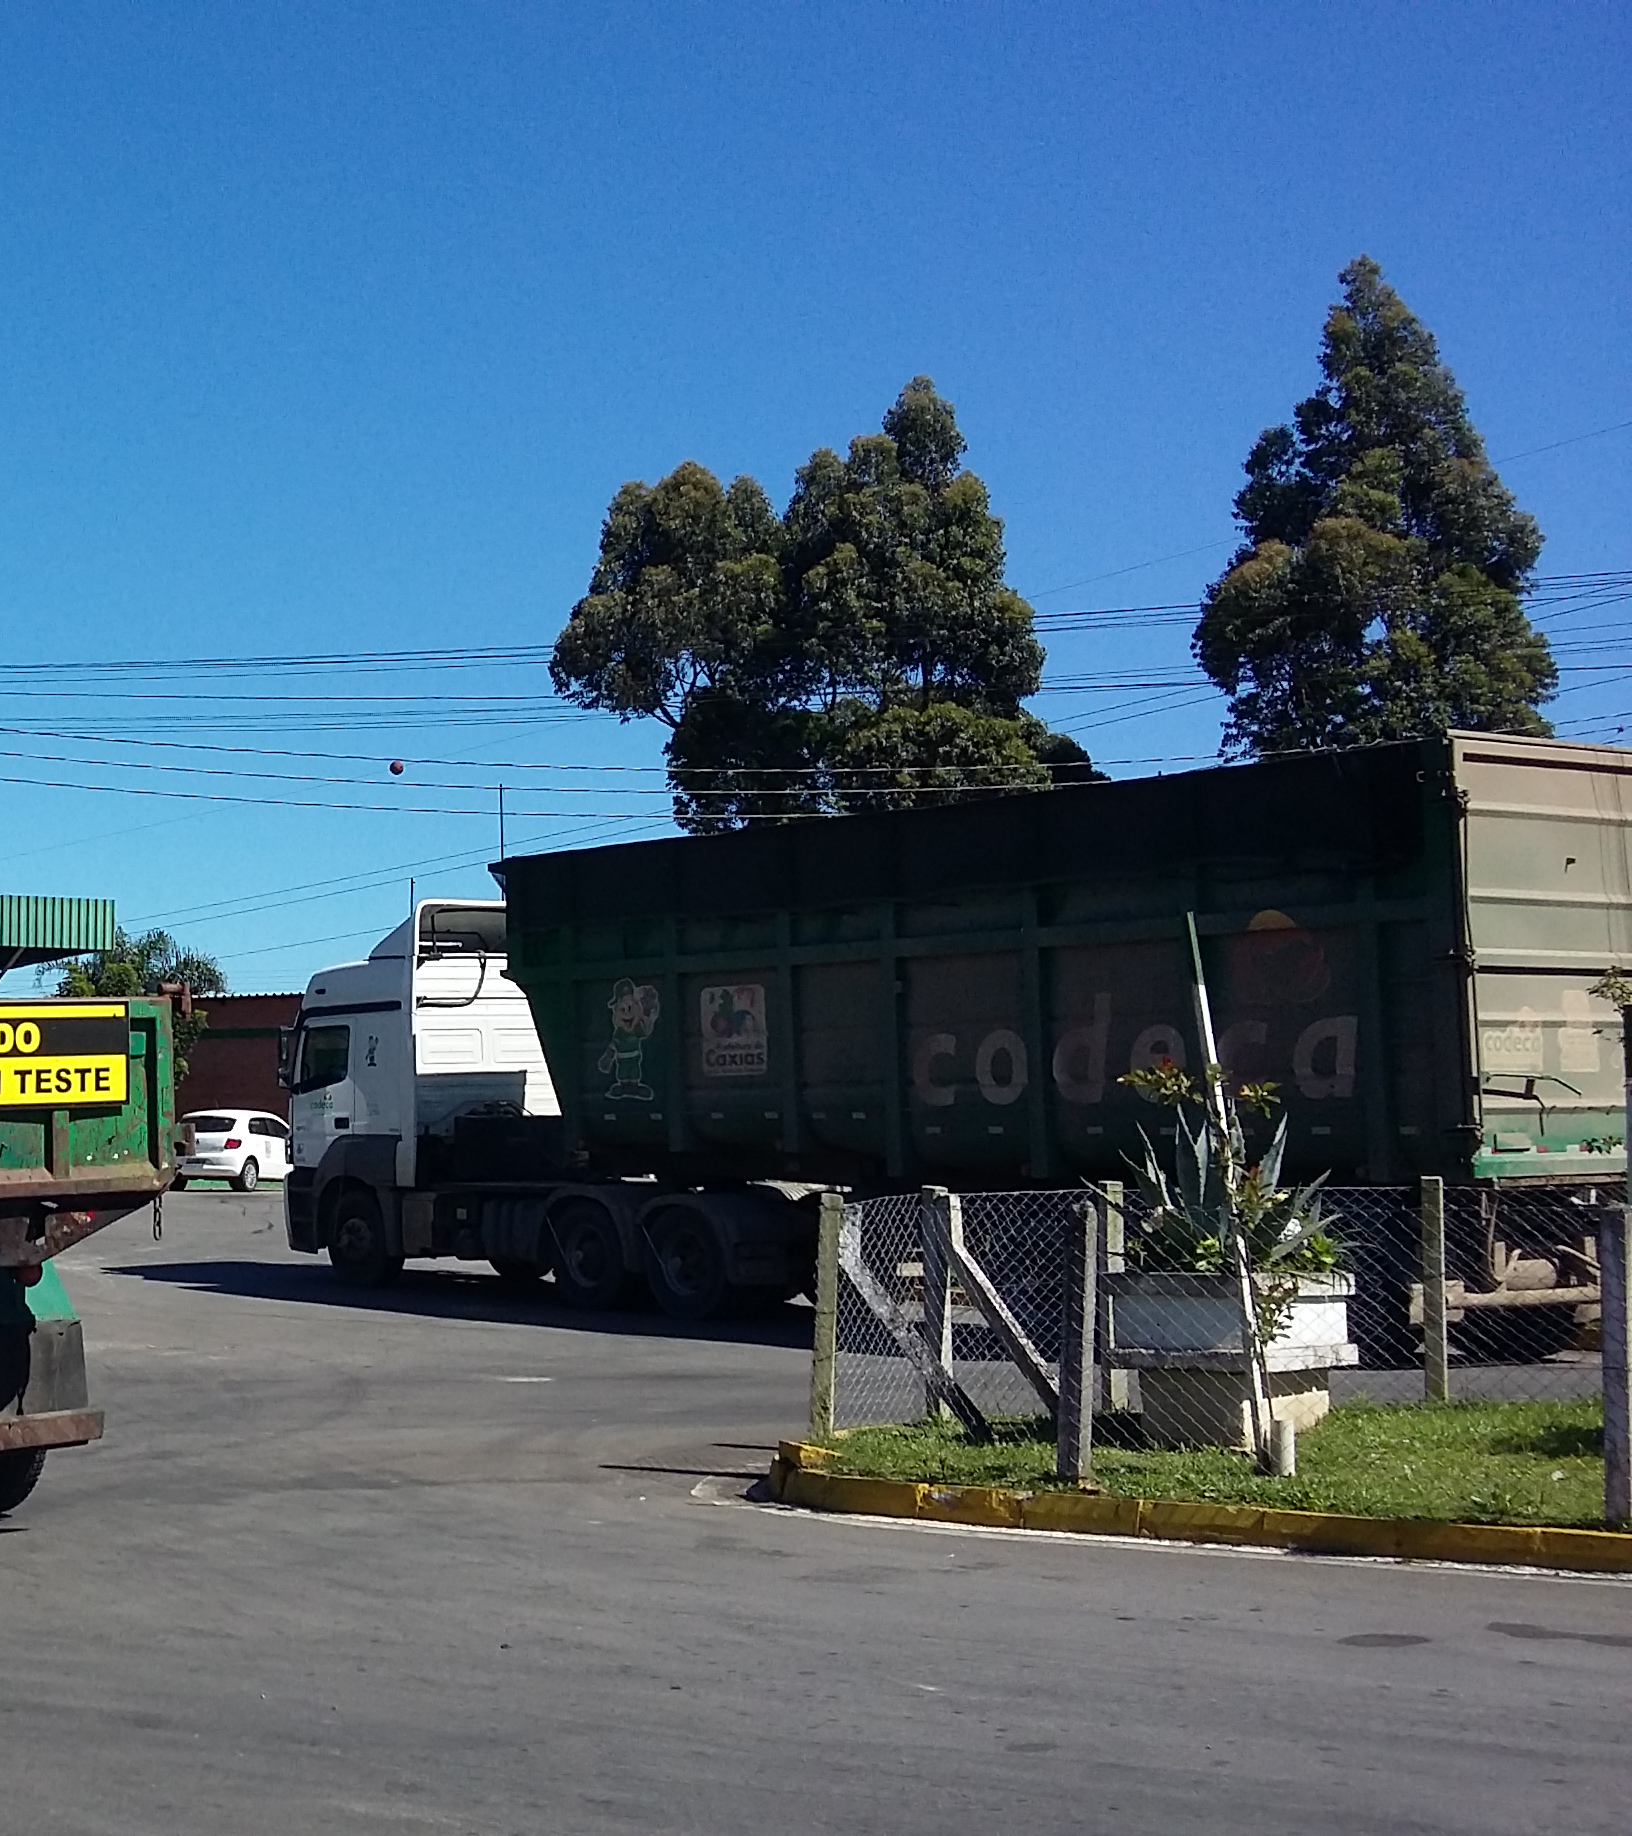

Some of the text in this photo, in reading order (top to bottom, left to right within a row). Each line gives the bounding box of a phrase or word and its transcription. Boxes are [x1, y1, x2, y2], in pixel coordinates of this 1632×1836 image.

[705, 1048, 765, 1068] Caxias
[911, 992, 1359, 1107] codeca
[13, 1067, 111, 1094] TESTE
